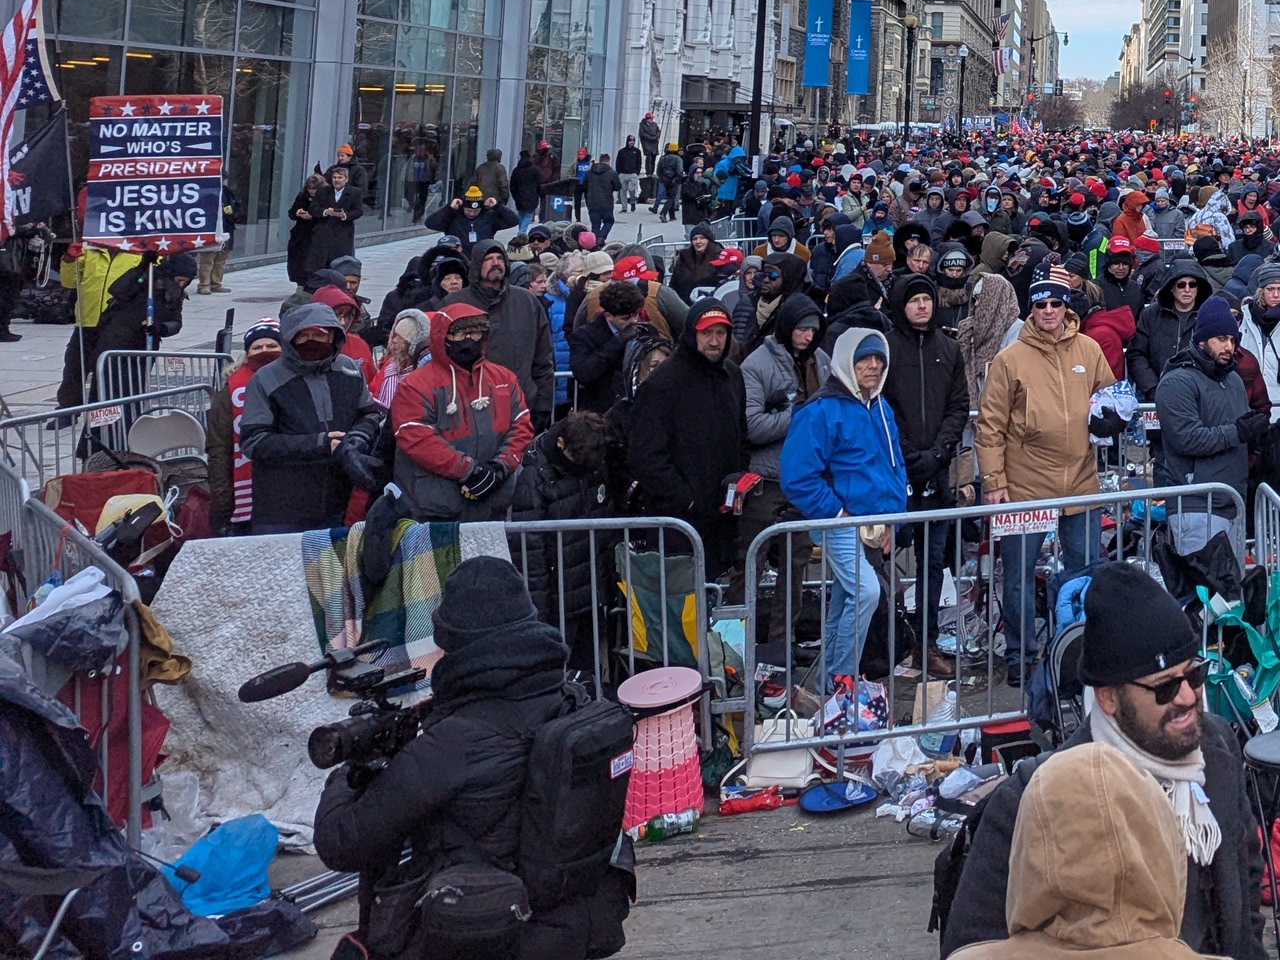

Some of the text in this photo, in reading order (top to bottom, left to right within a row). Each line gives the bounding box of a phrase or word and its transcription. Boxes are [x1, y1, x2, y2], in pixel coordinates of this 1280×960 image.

[99, 122, 212, 138] NO MATTER
[126, 141, 182, 154] WHO'S
[98, 160, 211, 177] PRESIDENT
[106, 183, 200, 208] JESUS
[553, 197, 563, 210] P
[98, 207, 207, 233] IS KING
[90, 406, 119, 419] NATIONAL
[995, 510, 1056, 526] NATIONAL
